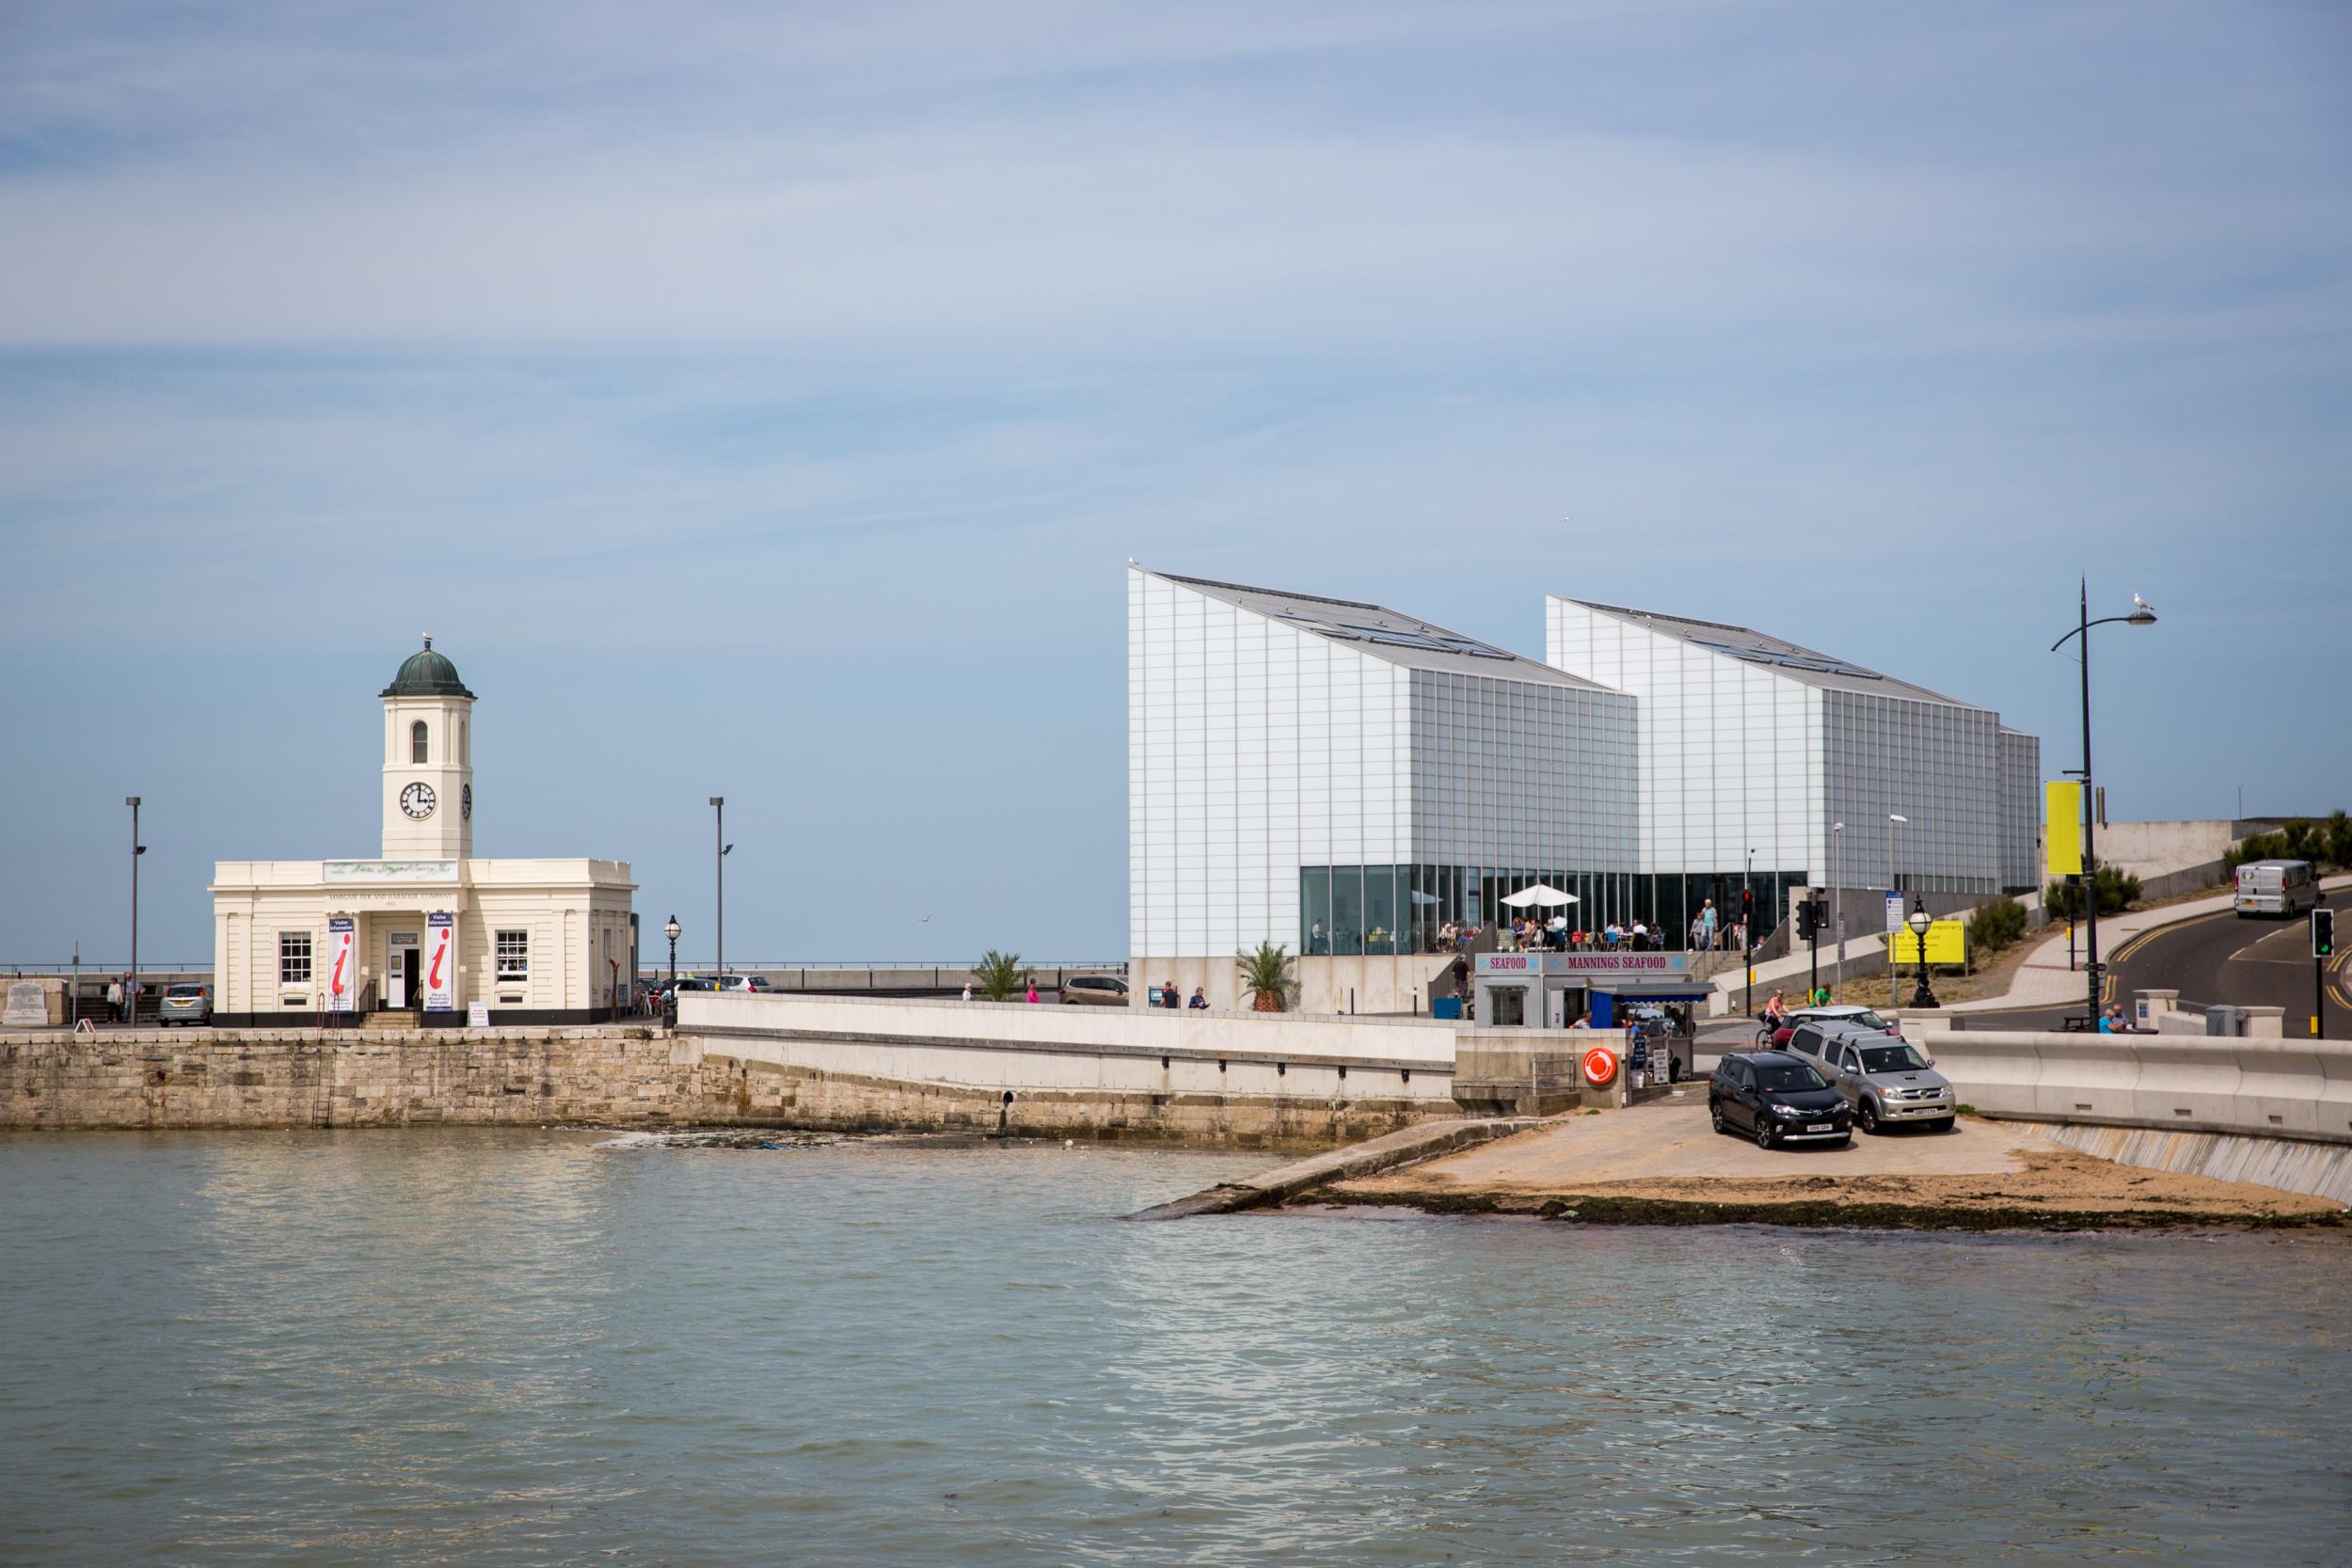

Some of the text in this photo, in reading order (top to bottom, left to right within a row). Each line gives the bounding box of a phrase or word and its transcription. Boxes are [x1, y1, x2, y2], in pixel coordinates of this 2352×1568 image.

[1490, 957, 1527, 969] SEAFOOD
[1567, 956, 1666, 969] MANNINGS SEAFOOD
